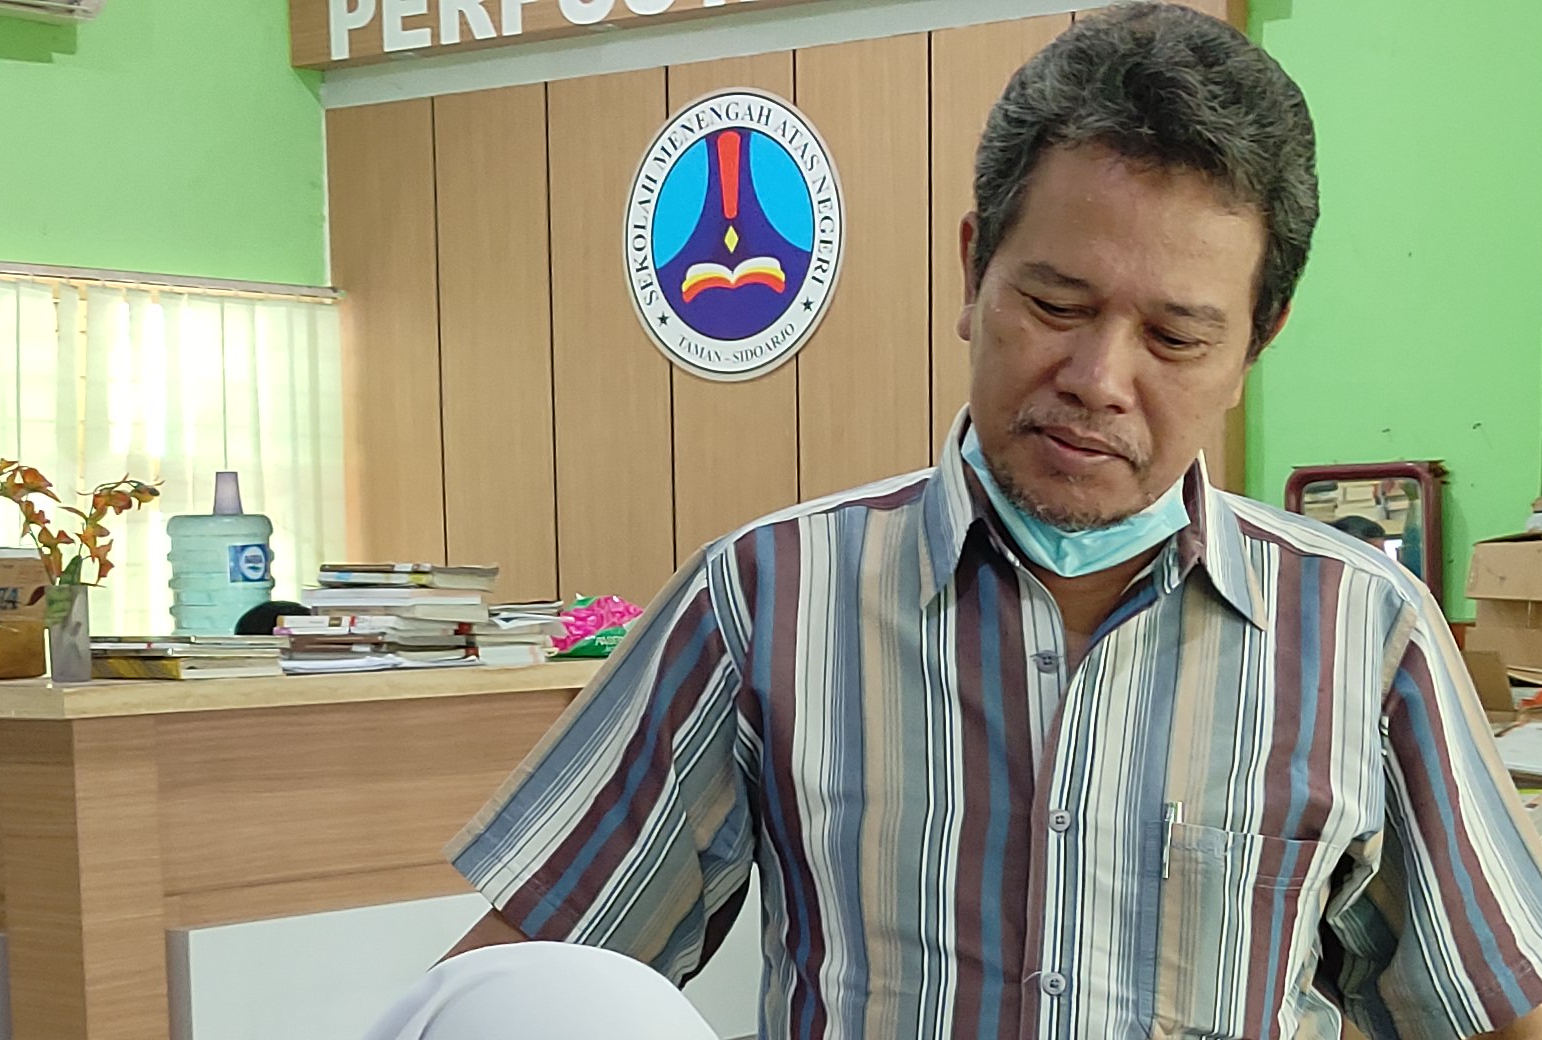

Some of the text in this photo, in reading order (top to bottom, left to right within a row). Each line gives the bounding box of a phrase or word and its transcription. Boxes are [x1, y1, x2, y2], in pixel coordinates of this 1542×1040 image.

[632, 101, 835, 306] SEKOLAH MENENGAH ATAS NEGERI
[678, 333, 723, 363] TAMAN
[732, 322, 796, 363] SIDOARJO
